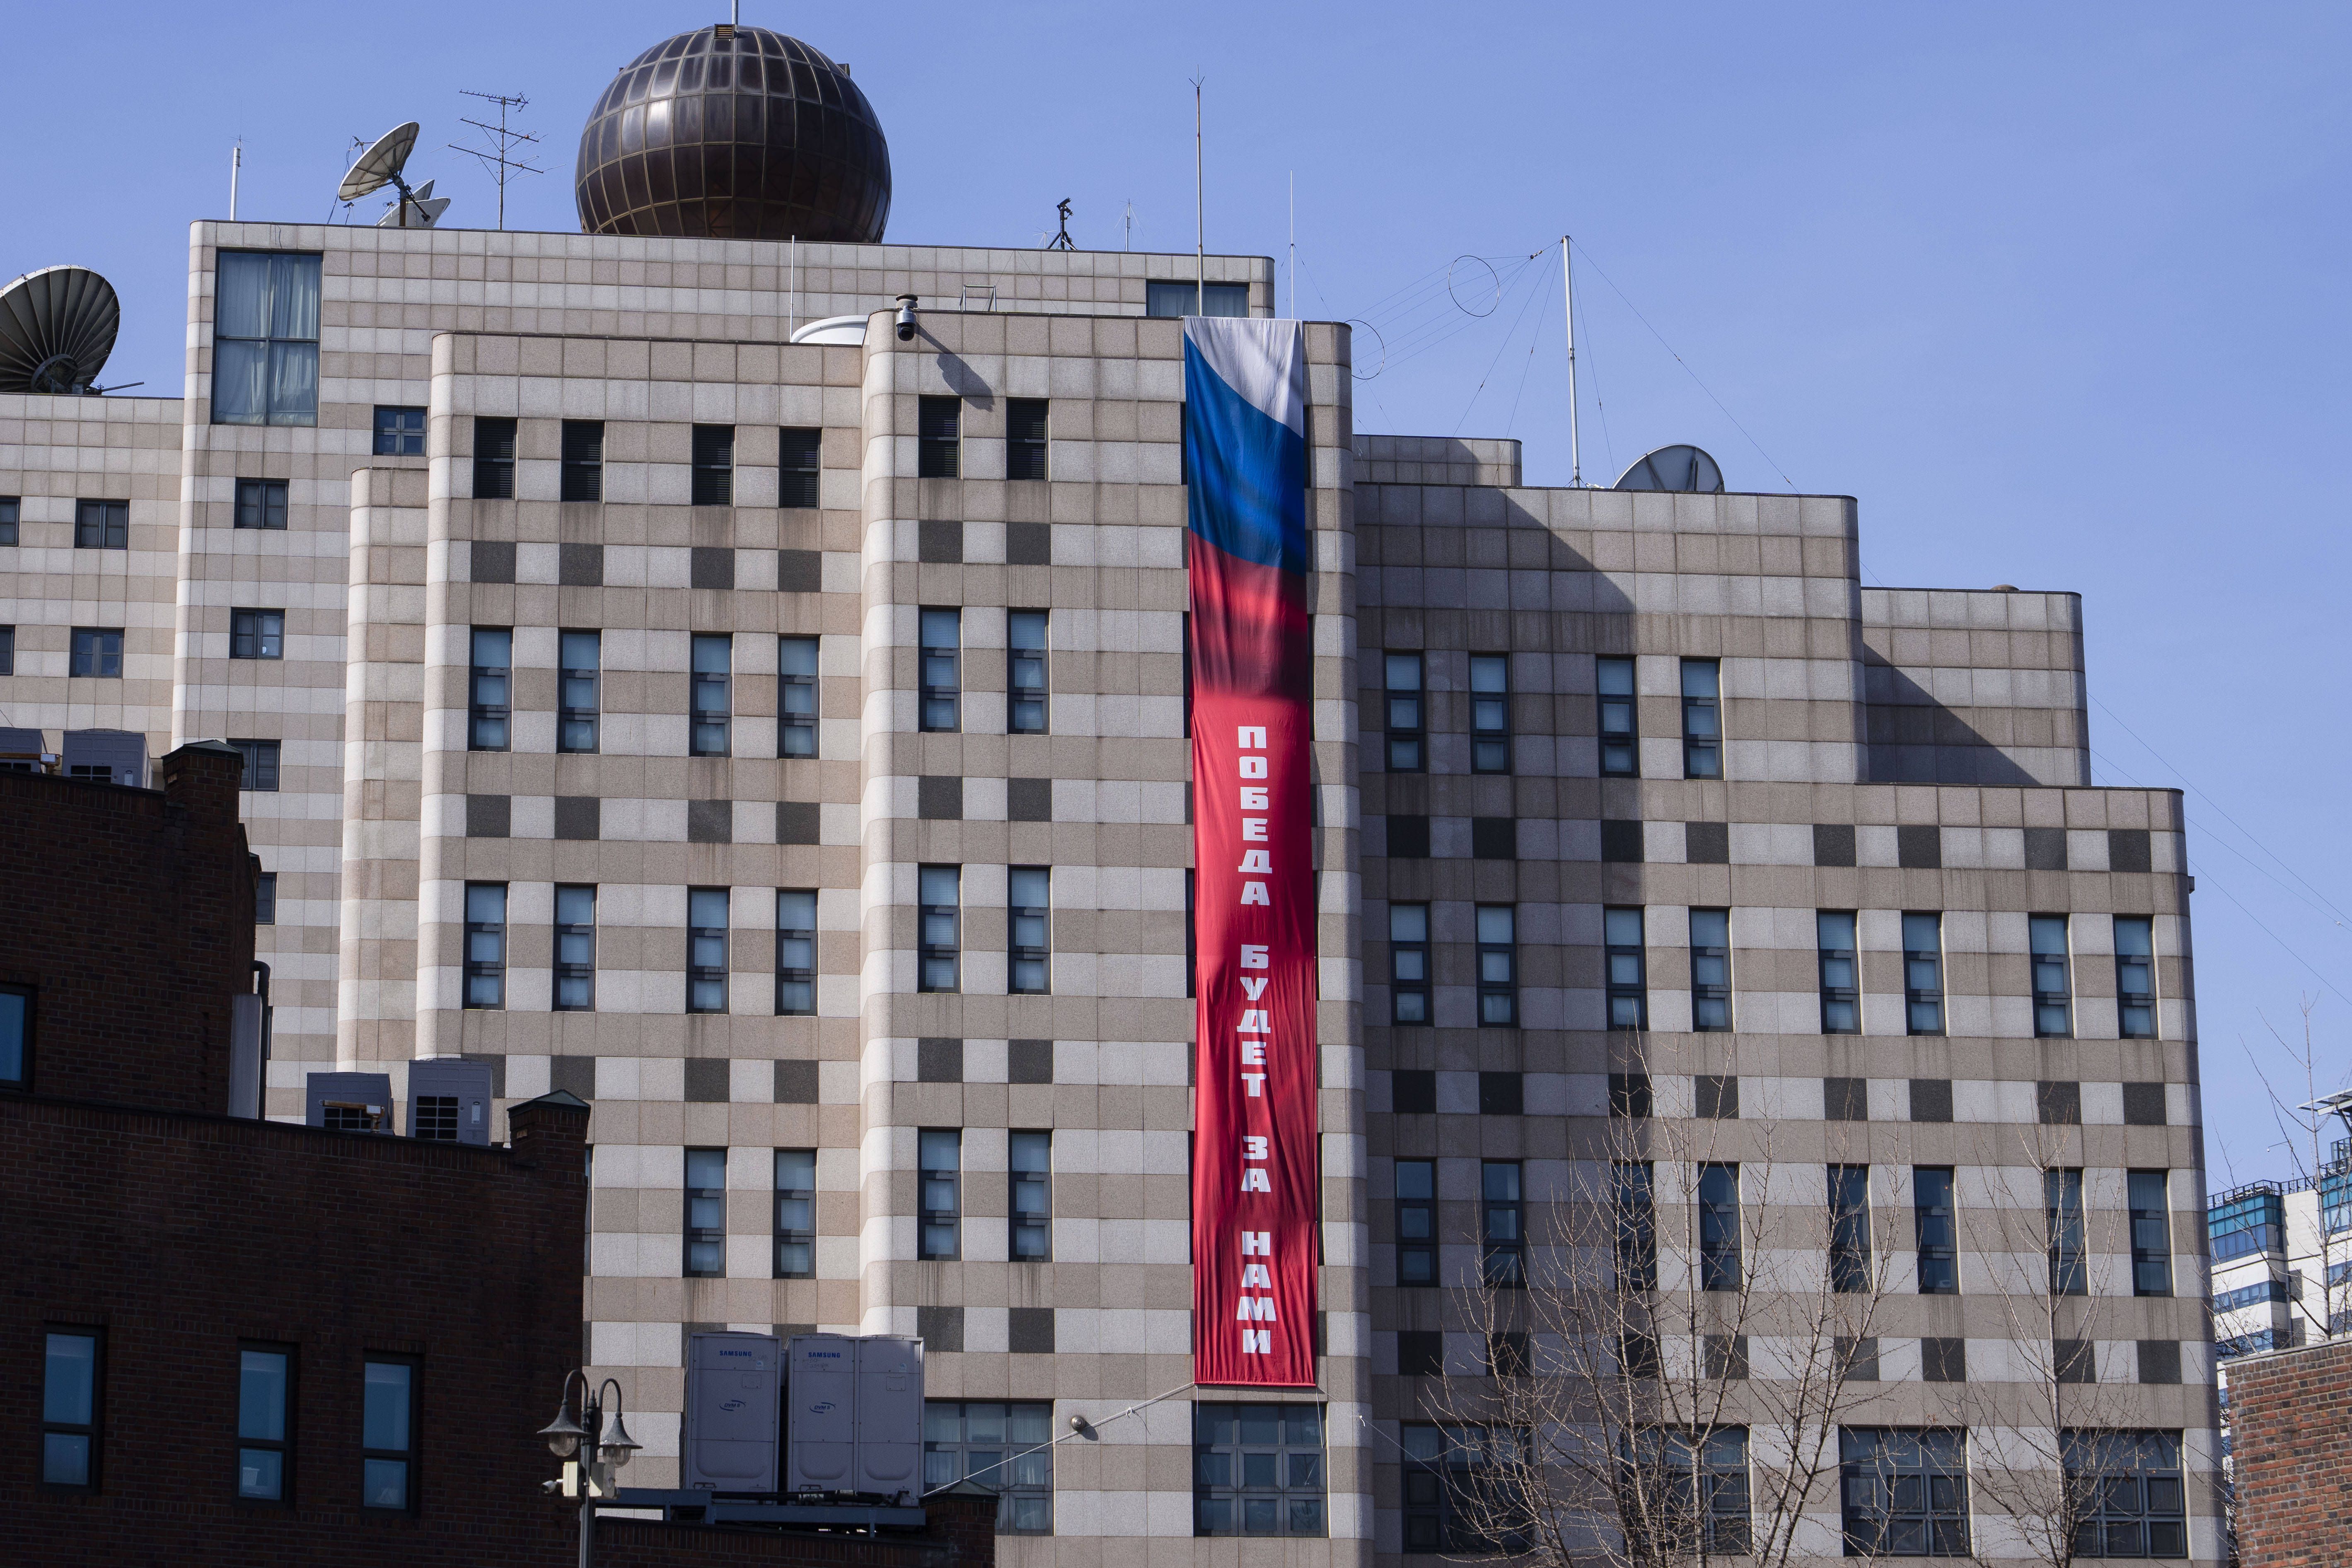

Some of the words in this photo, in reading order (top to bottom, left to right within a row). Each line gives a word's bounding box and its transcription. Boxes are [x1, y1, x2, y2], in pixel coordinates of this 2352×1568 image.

[1238, 726, 1272, 905] ПОБЕДА
[1237, 945, 1270, 1097] БУДЕТ
[1241, 1136, 1271, 1192] ЗА
[1237, 1231, 1276, 1353] НАМИ
